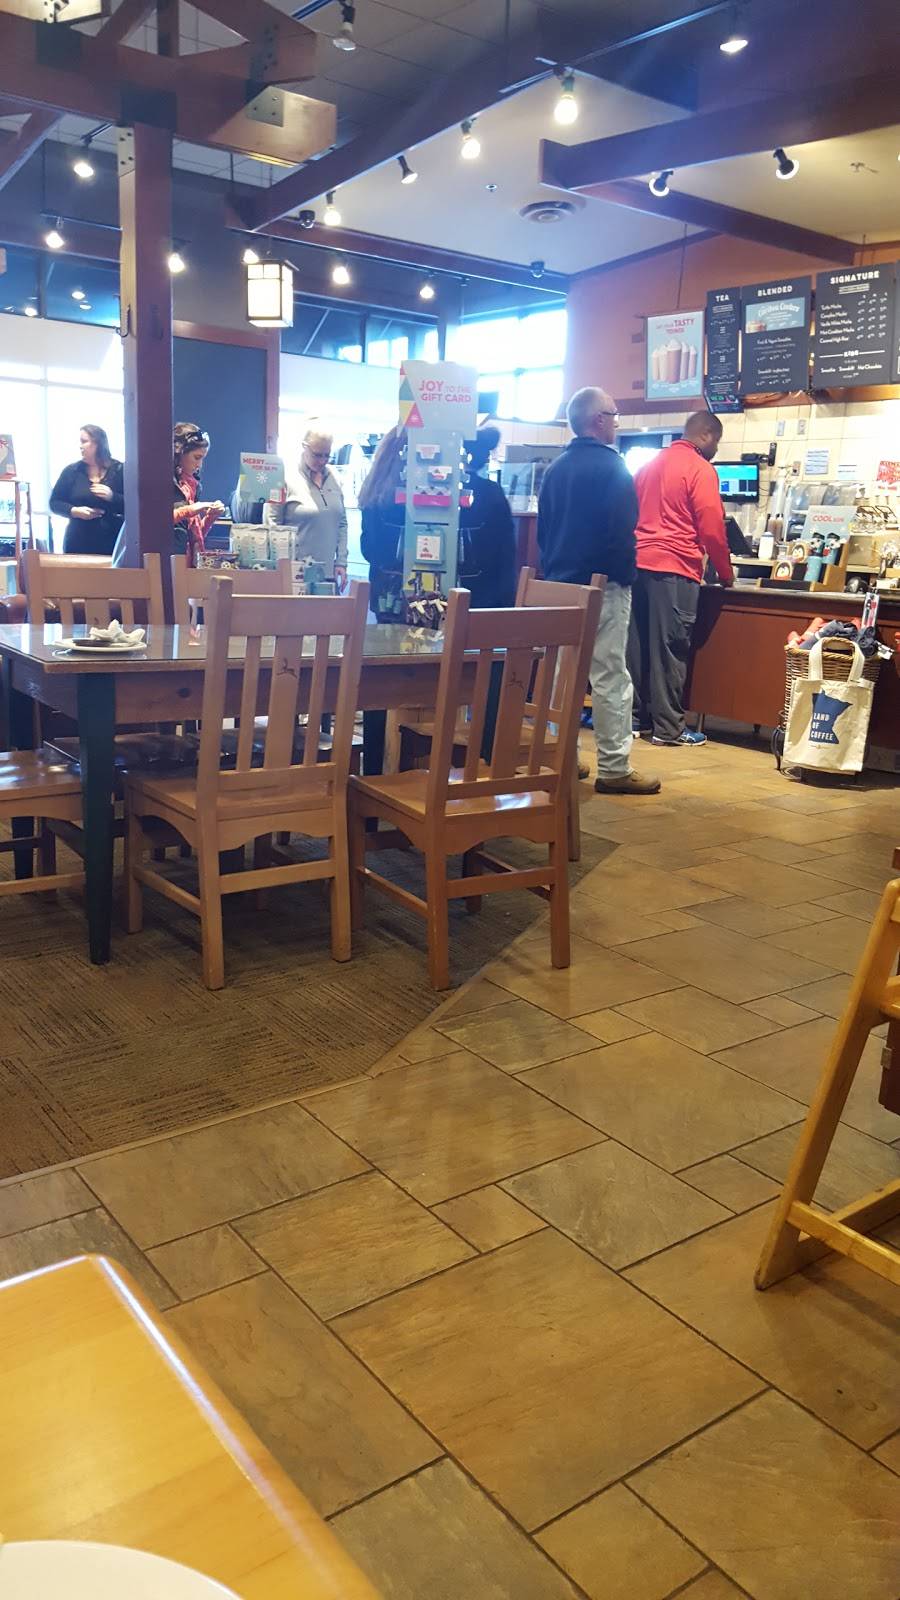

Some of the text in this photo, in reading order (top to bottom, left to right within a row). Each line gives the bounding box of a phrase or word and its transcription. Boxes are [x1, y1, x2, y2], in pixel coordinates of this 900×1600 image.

[830, 270, 880, 285] SIGNATURE
[757, 285, 793, 297] BLENDED
[715, 294, 730, 302] TEA
[674, 318, 695, 328] TASTY
[419, 380, 445, 392] JOY
[421, 393, 472, 403] GIFT CARD
[242, 457, 265, 465] MERRY
[813, 712, 830, 722] LAND
[812, 721, 820, 730] OF
[810, 730, 835, 741] COFFEE
